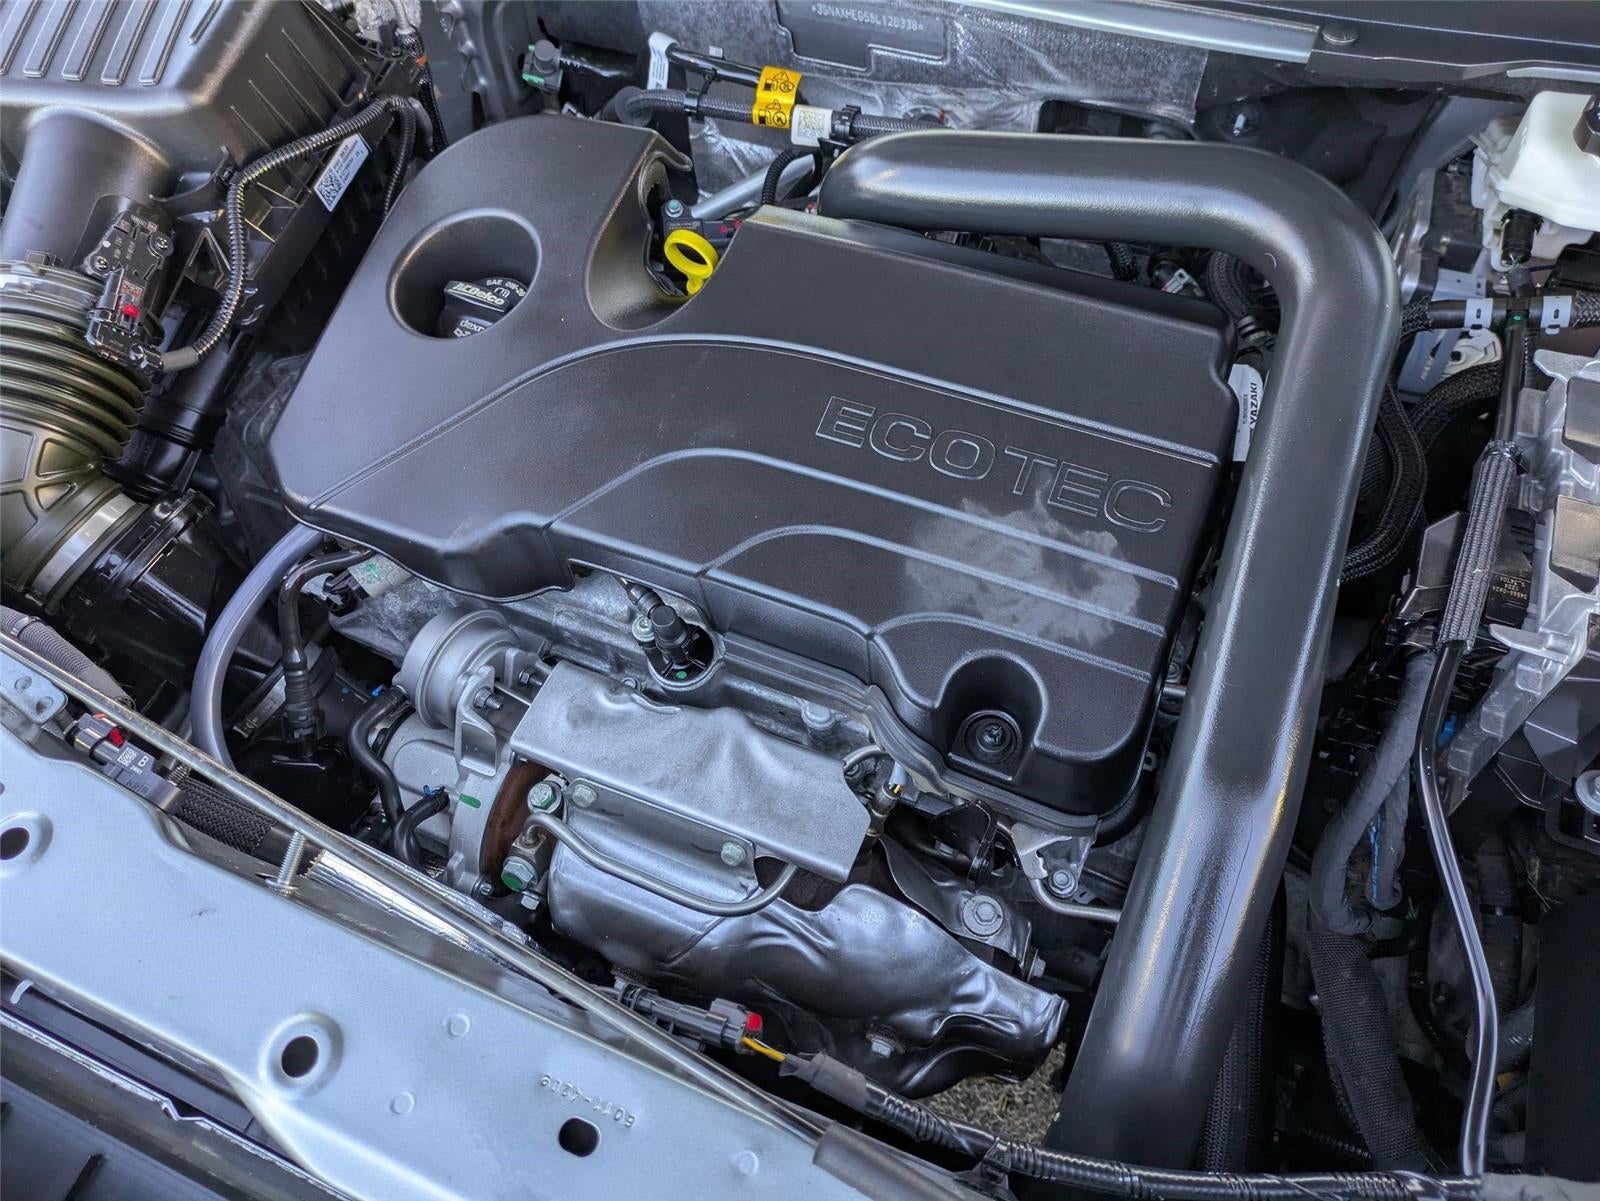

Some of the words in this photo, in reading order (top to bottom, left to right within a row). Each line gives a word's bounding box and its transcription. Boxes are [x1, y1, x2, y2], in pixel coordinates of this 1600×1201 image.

[451, 282, 505, 305] ACDelco
[1249, 382, 1258, 425] YAZAKI
[815, 395, 1172, 534] ECOTEC
[137, 755, 149, 767] B
